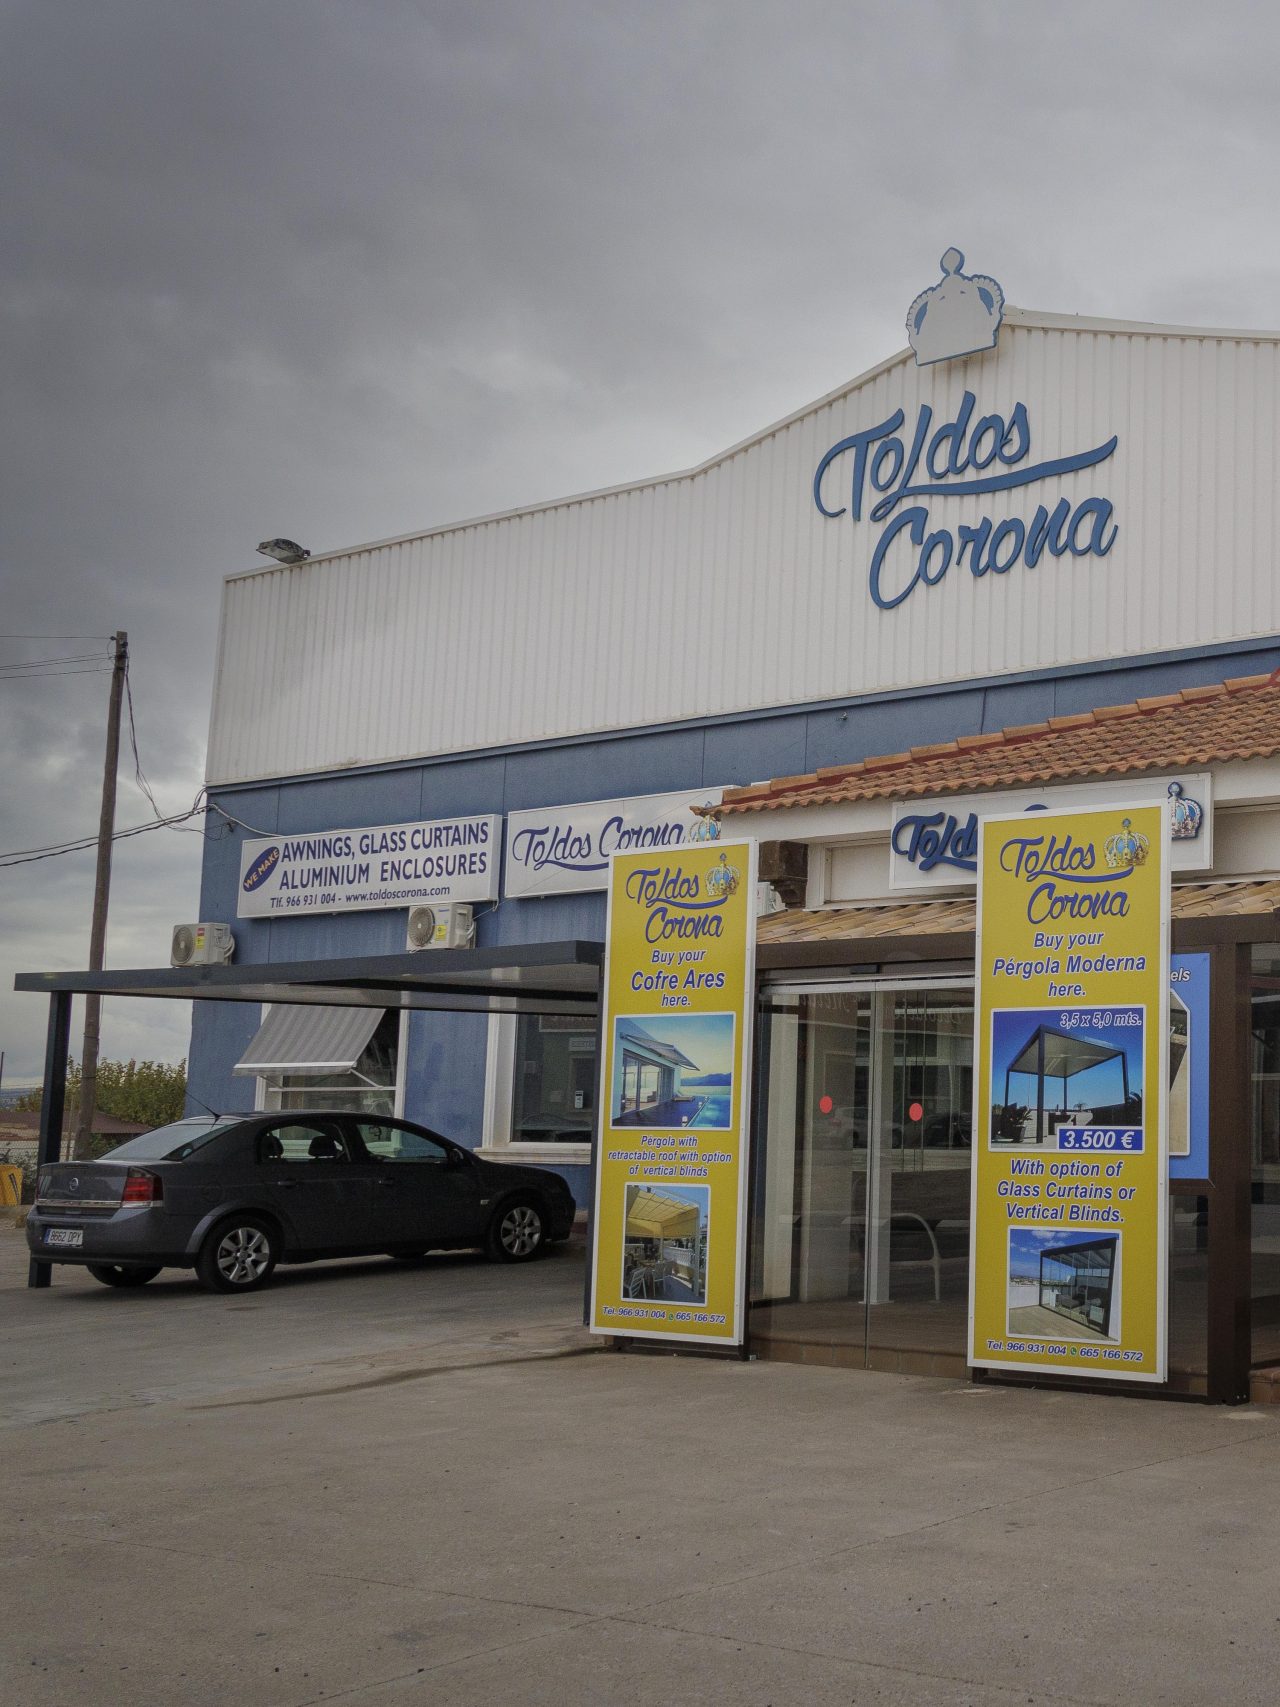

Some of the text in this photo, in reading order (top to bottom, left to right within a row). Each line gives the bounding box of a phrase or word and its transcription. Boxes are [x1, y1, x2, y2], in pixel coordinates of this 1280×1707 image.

[813, 390, 1118, 523] Toldos
[869, 497, 1119, 610] Corona
[281, 822, 489, 862] AWNINGS, GLASS CURTAINS
[512, 816, 686, 871] Toldos Corona
[891, 811, 978, 872] Told
[244, 849, 280, 889] WE MAKE
[1000, 835, 1133, 882] Toldos
[280, 852, 487, 890] ALUMINIUM ENCLOSURES
[286, 896, 301, 907] 966
[303, 894, 318, 905] 931
[321, 893, 336, 904] 004
[345, 886, 450, 902] www.toldoscorona.com
[626, 867, 728, 909] Toldos
[1027, 883, 1130, 924] Corona
[645, 907, 724, 943] Corona
[1033, 932, 1104, 949] Buy your
[651, 950, 706, 965] Buy your
[993, 954, 1146, 979] Pérgola Moderna
[631, 969, 725, 991] Cofre Ares
[1048, 980, 1086, 997] here.
[661, 993, 691, 1007] here.
[1060, 1012, 1143, 1029] 3,5 x 5,0 mts.
[678, 1135, 698, 1147] with
[1064, 1131, 1135, 1148] 3.500 €
[608, 1151, 732, 1163] retractable roof with option
[629, 1165, 708, 1177] of vertical blinds
[1010, 1159, 1123, 1179] With option of
[997, 1181, 1136, 1200] Glass Curtains or
[1006, 1203, 1124, 1222] Vertical Blinds.
[602, 1306, 726, 1324] Tel. 966 931 004 665 166 572
[987, 1340, 1144, 1361] Tel. 966 931 004 665 166 572
